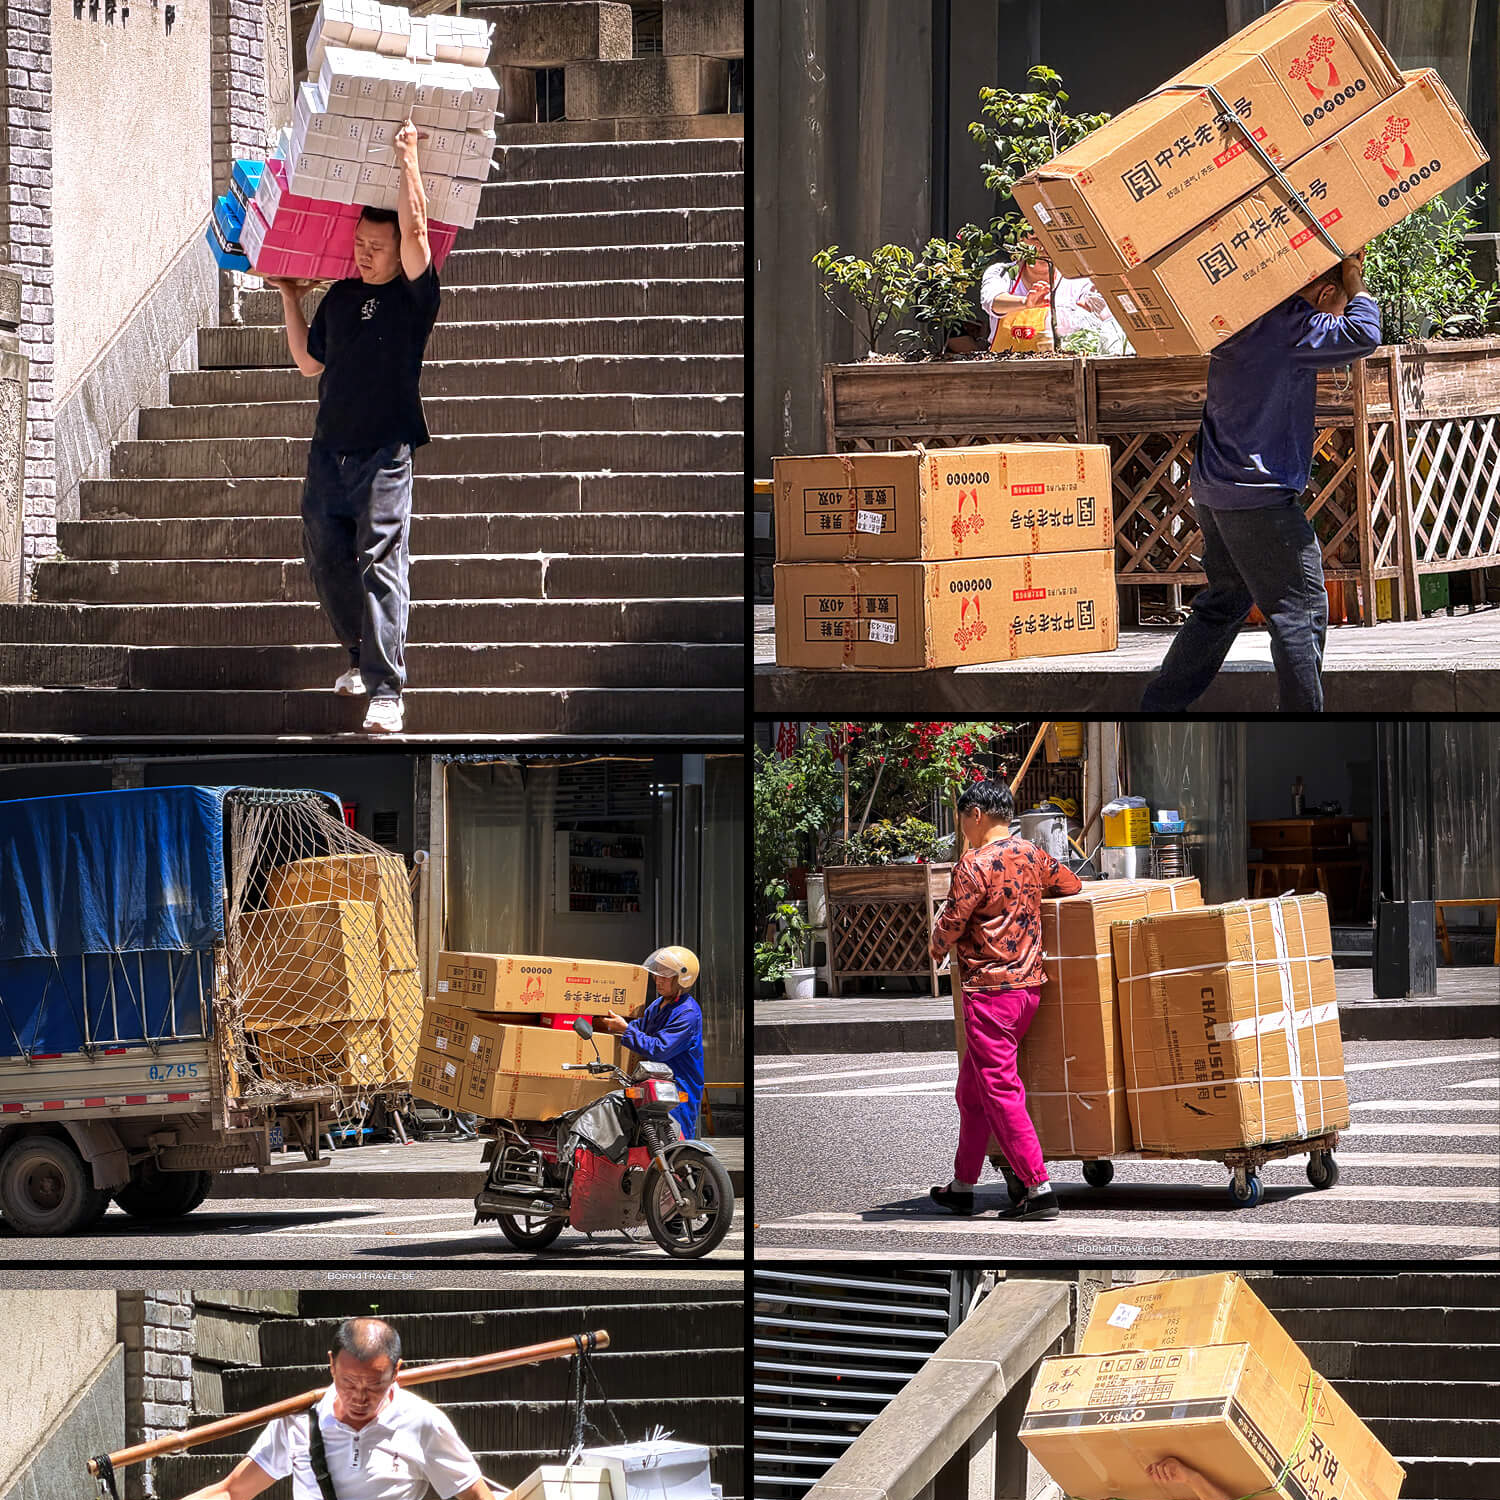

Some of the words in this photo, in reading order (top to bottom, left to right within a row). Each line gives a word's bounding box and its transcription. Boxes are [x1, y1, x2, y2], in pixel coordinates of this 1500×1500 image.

[819, 513, 843, 530] 男鞋
[1010, 506, 1074, 529] 中华老字号
[819, 620, 843, 636] 男鞋
[1012, 612, 1074, 635] 中华老字号
